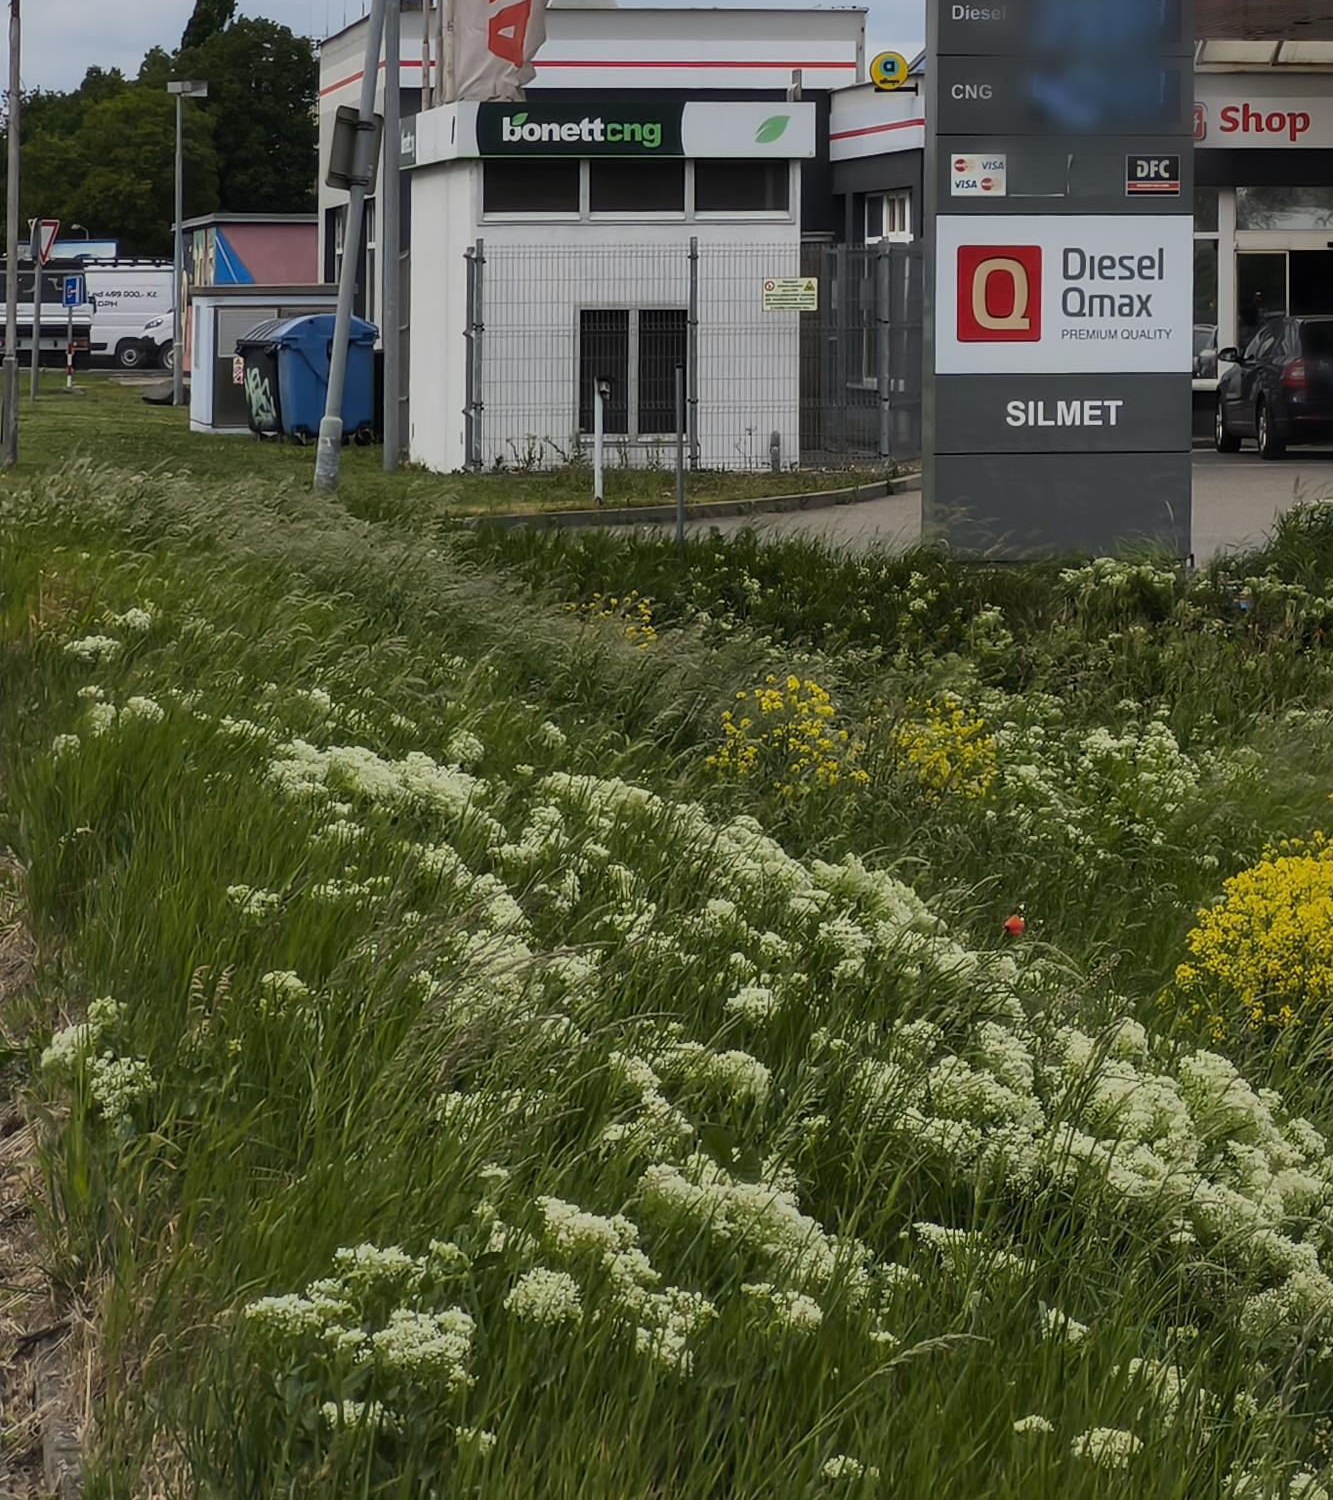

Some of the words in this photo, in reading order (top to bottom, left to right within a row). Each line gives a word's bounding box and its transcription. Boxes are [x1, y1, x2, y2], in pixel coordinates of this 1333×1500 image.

[951, 83, 993, 100] CNG
[1219, 103, 1312, 142] Shop
[981, 160, 1005, 171] VISA
[1136, 159, 1170, 178] DFC
[954, 179, 978, 189] VISA
[1062, 247, 1164, 281] Diesel
[972, 258, 1031, 330] Q
[1061, 286, 1153, 318] Qmax
[1061, 328, 1118, 340] PREMIUM
[1120, 328, 1173, 340] QUALITY
[1005, 400, 1124, 427] SILMET
